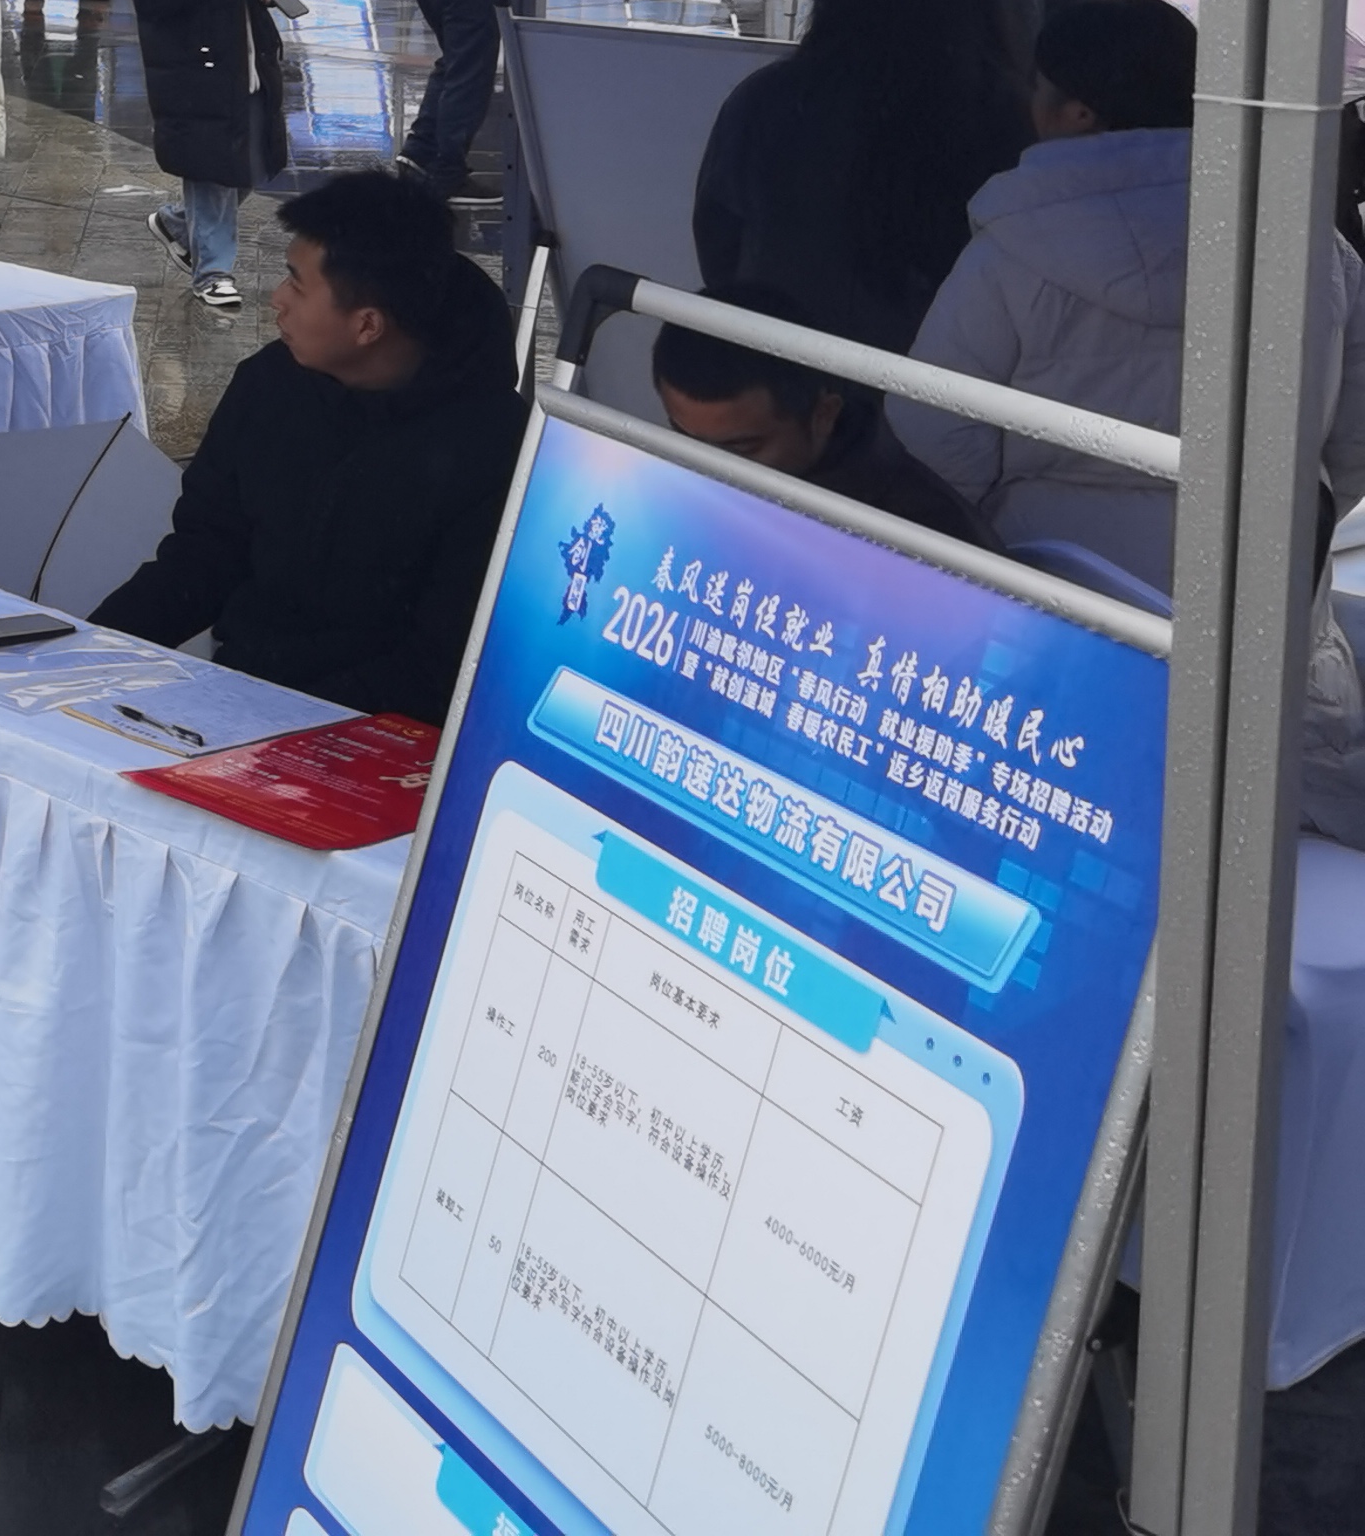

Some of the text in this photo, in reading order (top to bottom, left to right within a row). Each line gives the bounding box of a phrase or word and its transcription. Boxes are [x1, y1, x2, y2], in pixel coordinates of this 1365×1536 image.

[602, 586, 678, 665] 2026
[653, 546, 1083, 767] 春风送岗促就业 真情相助暖民心
[594, 701, 957, 934] 四川韵速达物流有限公司
[513, 881, 556, 919] 岗位名称
[571, 908, 596, 935] 用工
[664, 885, 798, 999] 招聘岗位
[648, 971, 721, 1029] 岗位基本要求
[484, 1005, 516, 1037] 操作工
[536, 1044, 557, 1068] 200
[834, 1095, 864, 1128] 工资
[487, 1234, 502, 1254] 50
